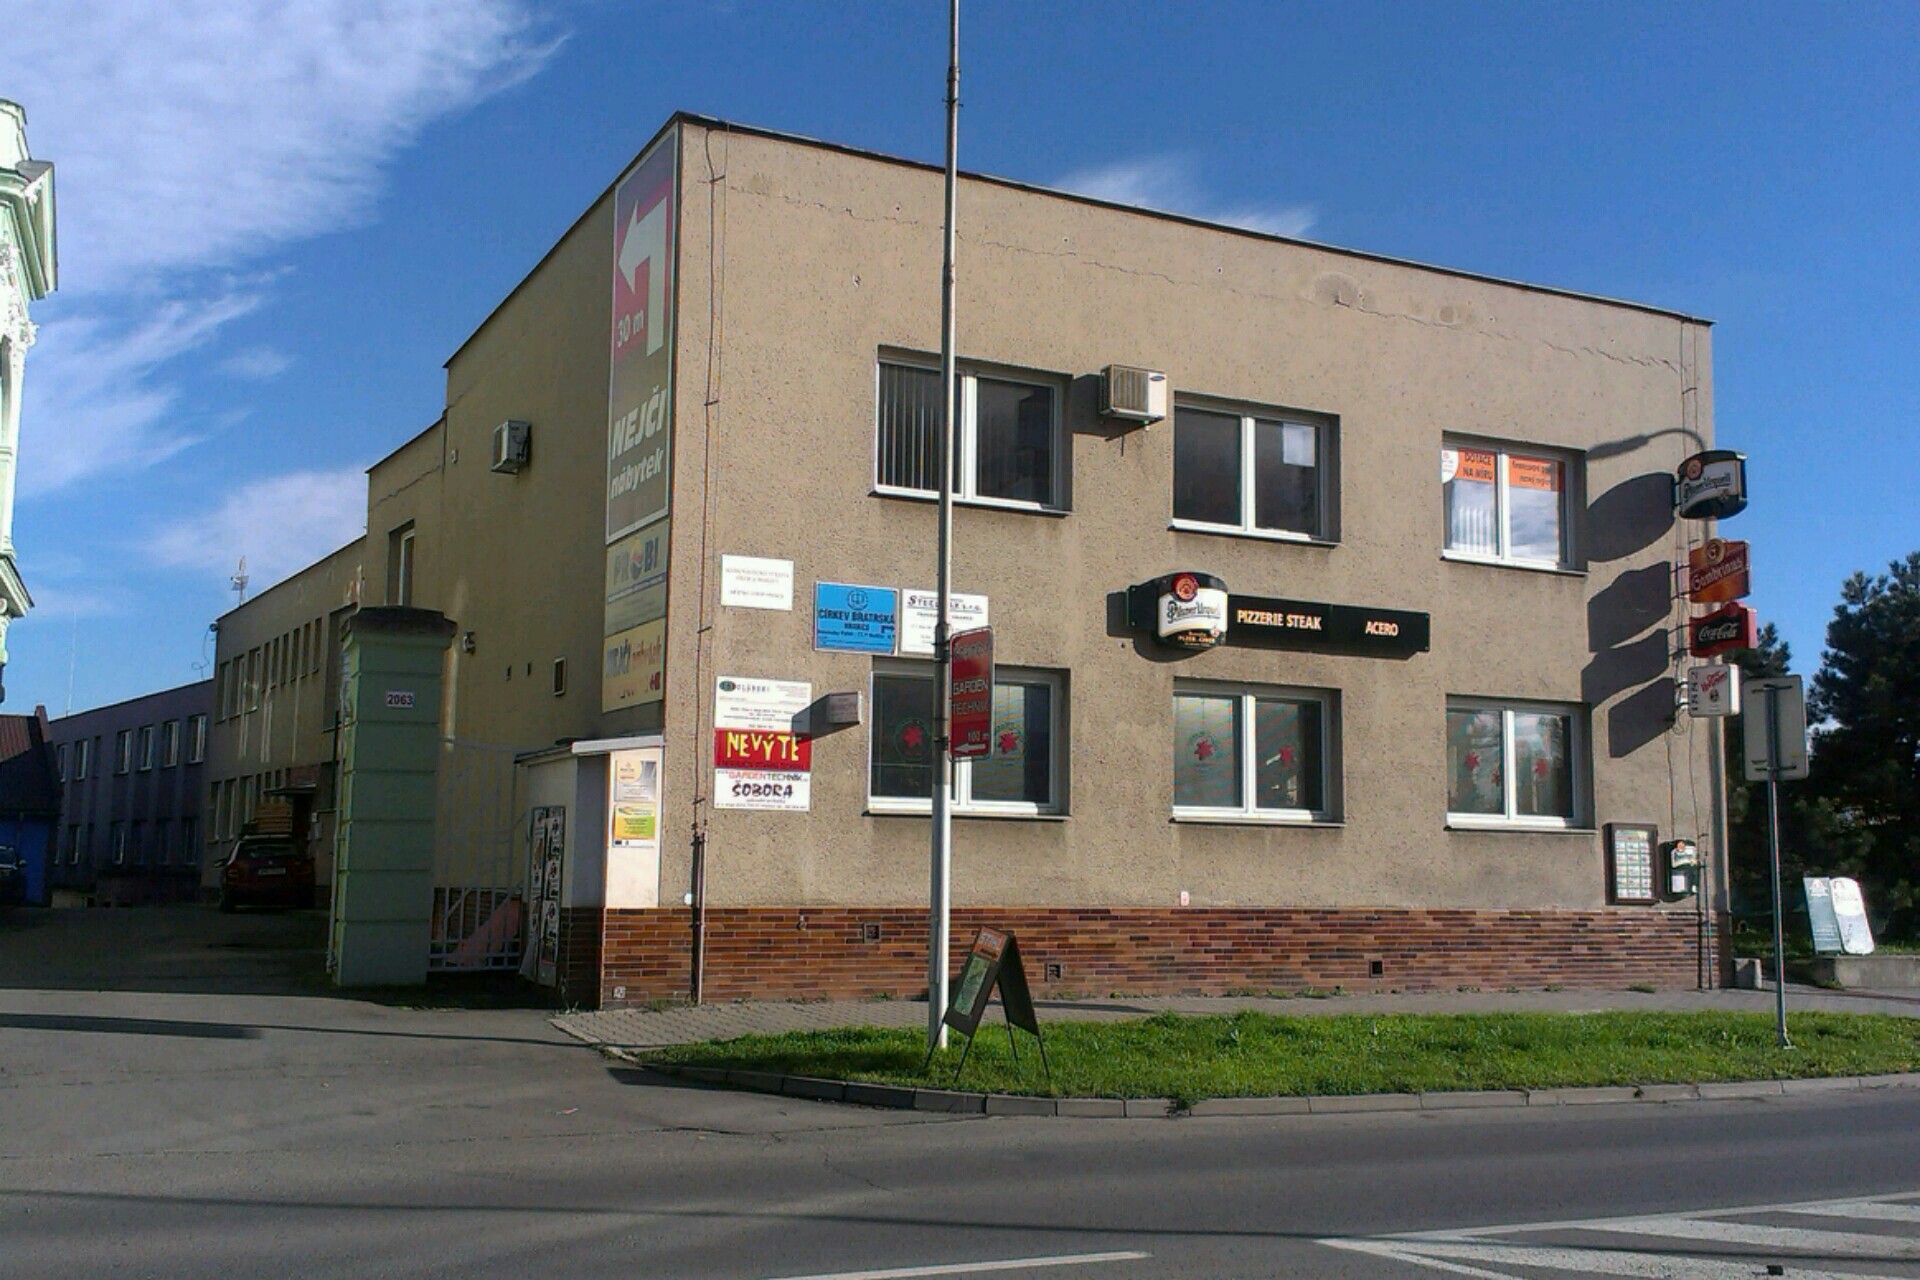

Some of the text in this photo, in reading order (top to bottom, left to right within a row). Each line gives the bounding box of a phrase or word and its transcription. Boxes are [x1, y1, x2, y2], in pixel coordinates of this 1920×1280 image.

[616, 313, 630, 349] 30
[610, 447, 664, 499] nábytek
[818, 608, 895, 624] CÍRKEV BRATRSKÁ
[1236, 610, 1399, 637] PIZZERIE STEAK ACERO
[953, 680, 989, 696] GARDEN
[386, 693, 414, 705] 2063
[953, 701, 989, 716] TECHNIK
